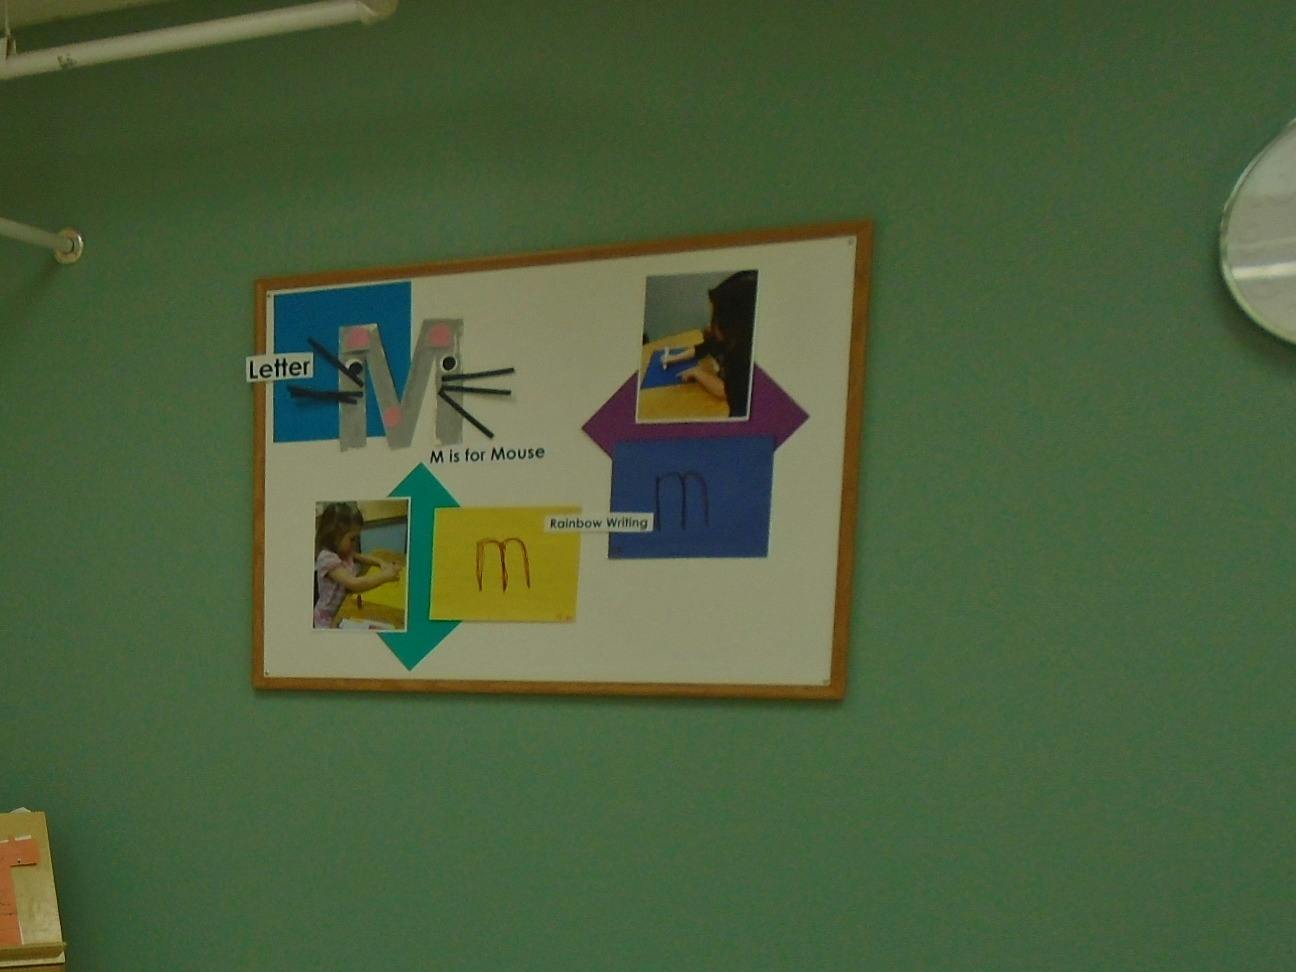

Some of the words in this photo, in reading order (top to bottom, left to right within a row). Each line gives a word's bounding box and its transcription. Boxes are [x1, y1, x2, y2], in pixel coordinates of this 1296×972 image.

[249, 359, 311, 380] Letter
[430, 450, 444, 463] M
[449, 448, 460, 462] is
[465, 447, 485, 462] for
[490, 446, 546, 461] Mouse
[550, 517, 603, 530] Rainbow
[605, 515, 648, 531] Writing
